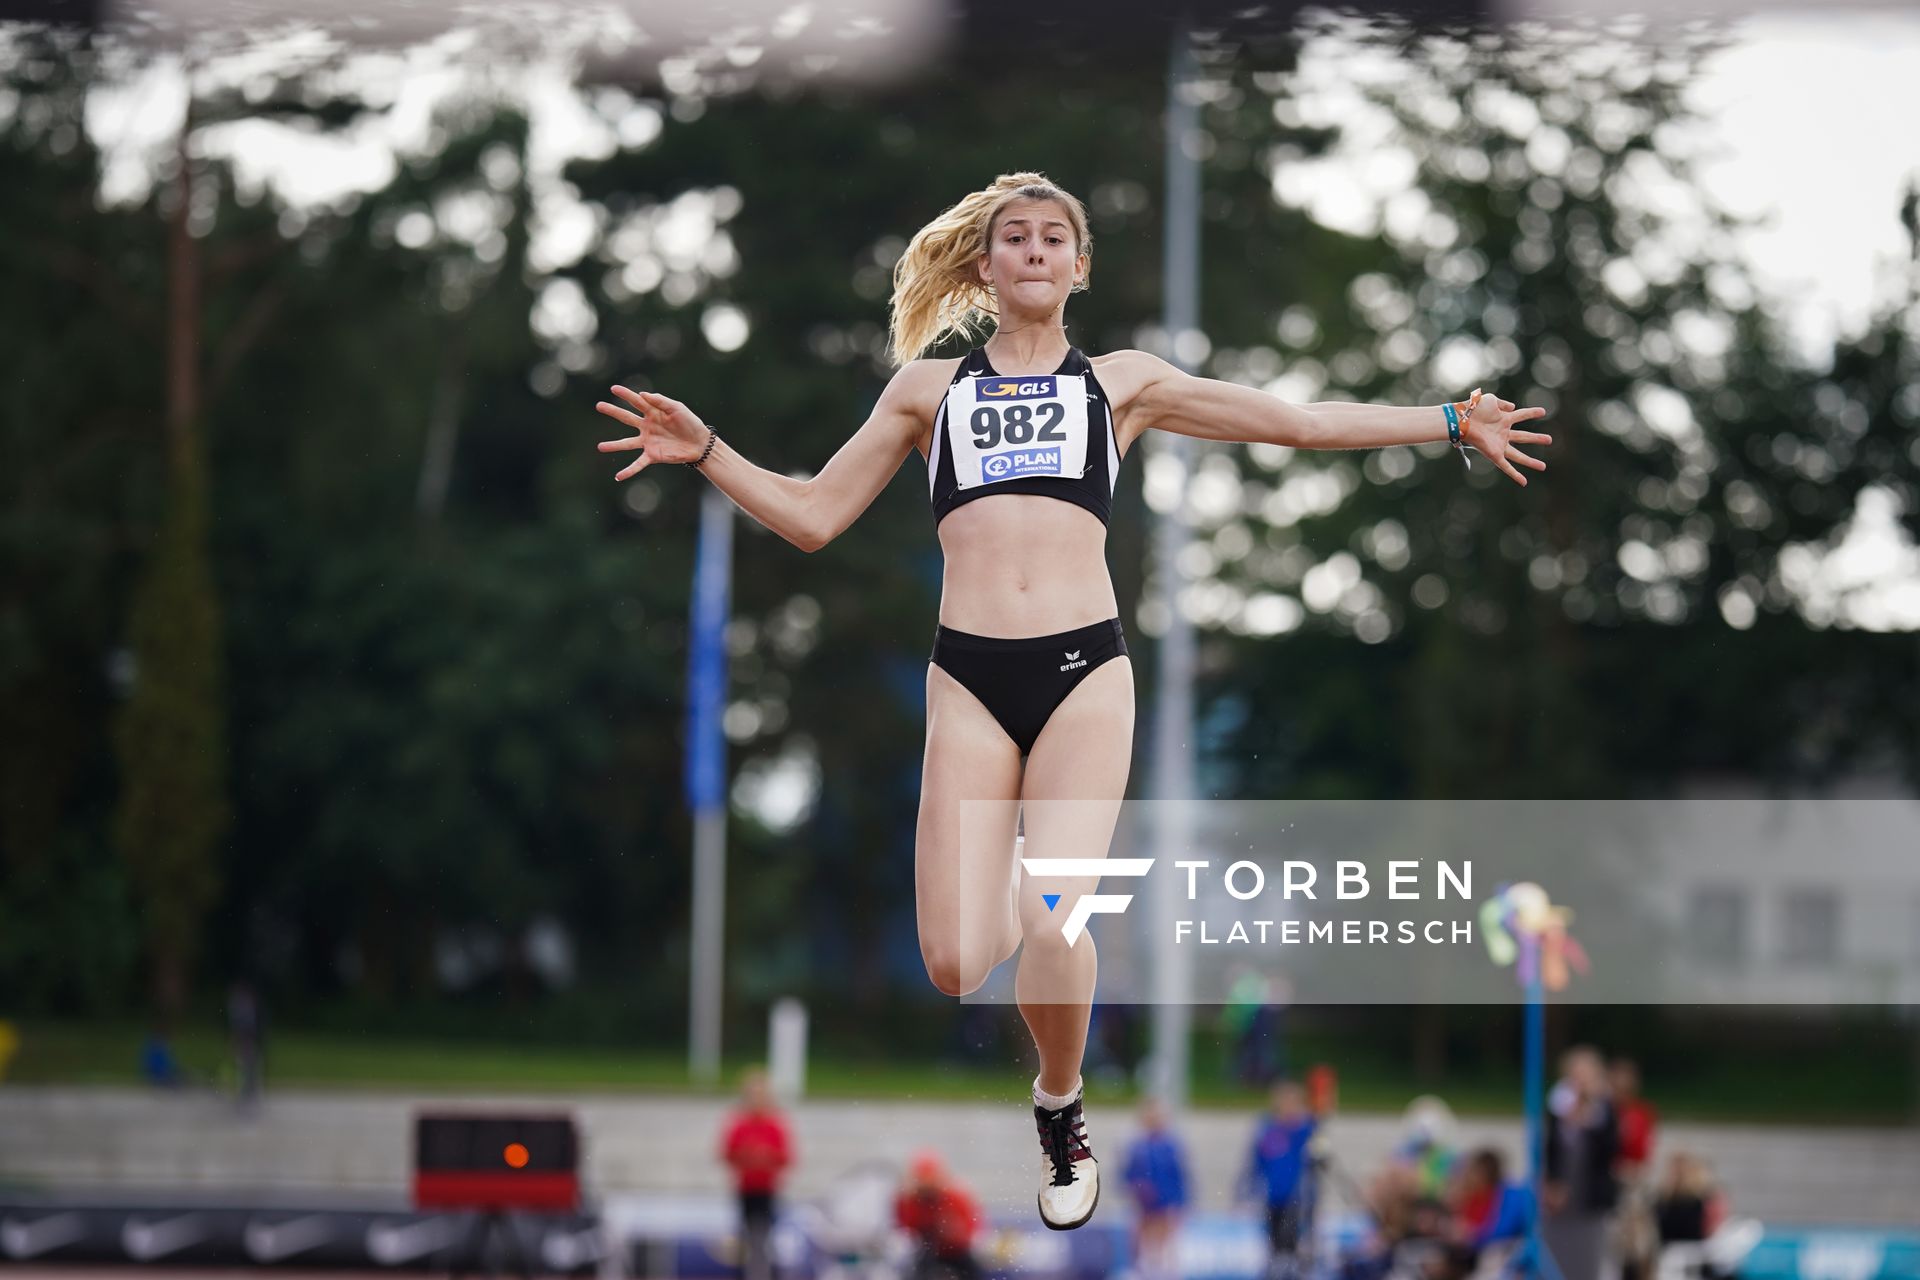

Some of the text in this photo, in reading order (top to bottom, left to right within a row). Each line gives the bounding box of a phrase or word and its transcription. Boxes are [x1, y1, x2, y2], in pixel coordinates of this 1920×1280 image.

[1019, 382, 1050, 395] GLS
[970, 402, 1067, 449] 982
[1014, 453, 1058, 467] PLAN
[1060, 659, 1087, 672] erima
